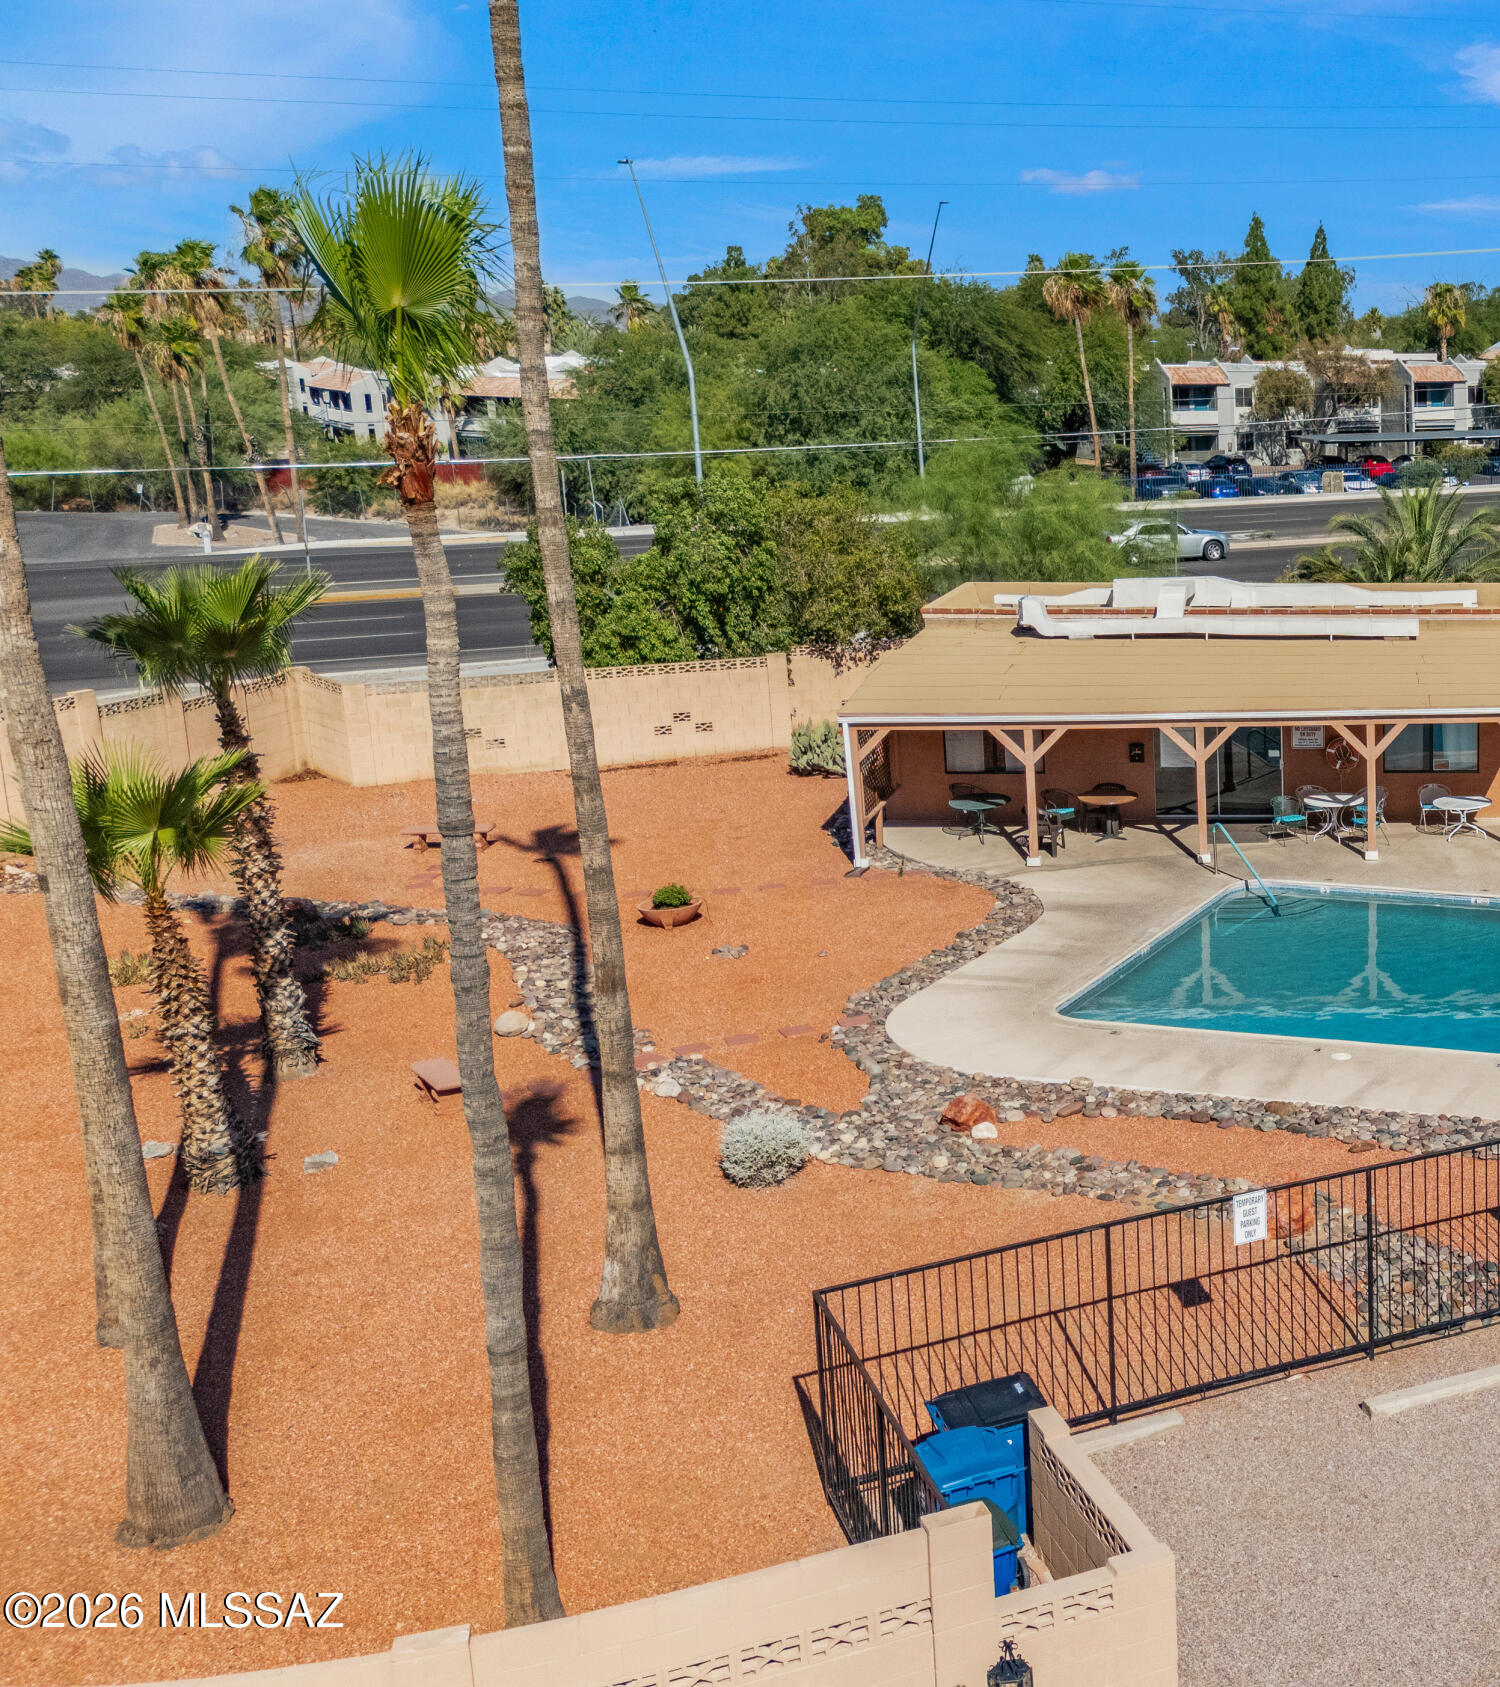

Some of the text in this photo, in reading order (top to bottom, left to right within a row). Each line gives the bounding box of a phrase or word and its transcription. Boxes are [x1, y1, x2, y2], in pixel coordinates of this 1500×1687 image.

[1235, 1195, 1264, 1208] TEMPORARY
[1242, 1206, 1258, 1217] GUEST
[1240, 1217, 1261, 1228] PARKING
[1244, 1229, 1257, 1239] ONLY
